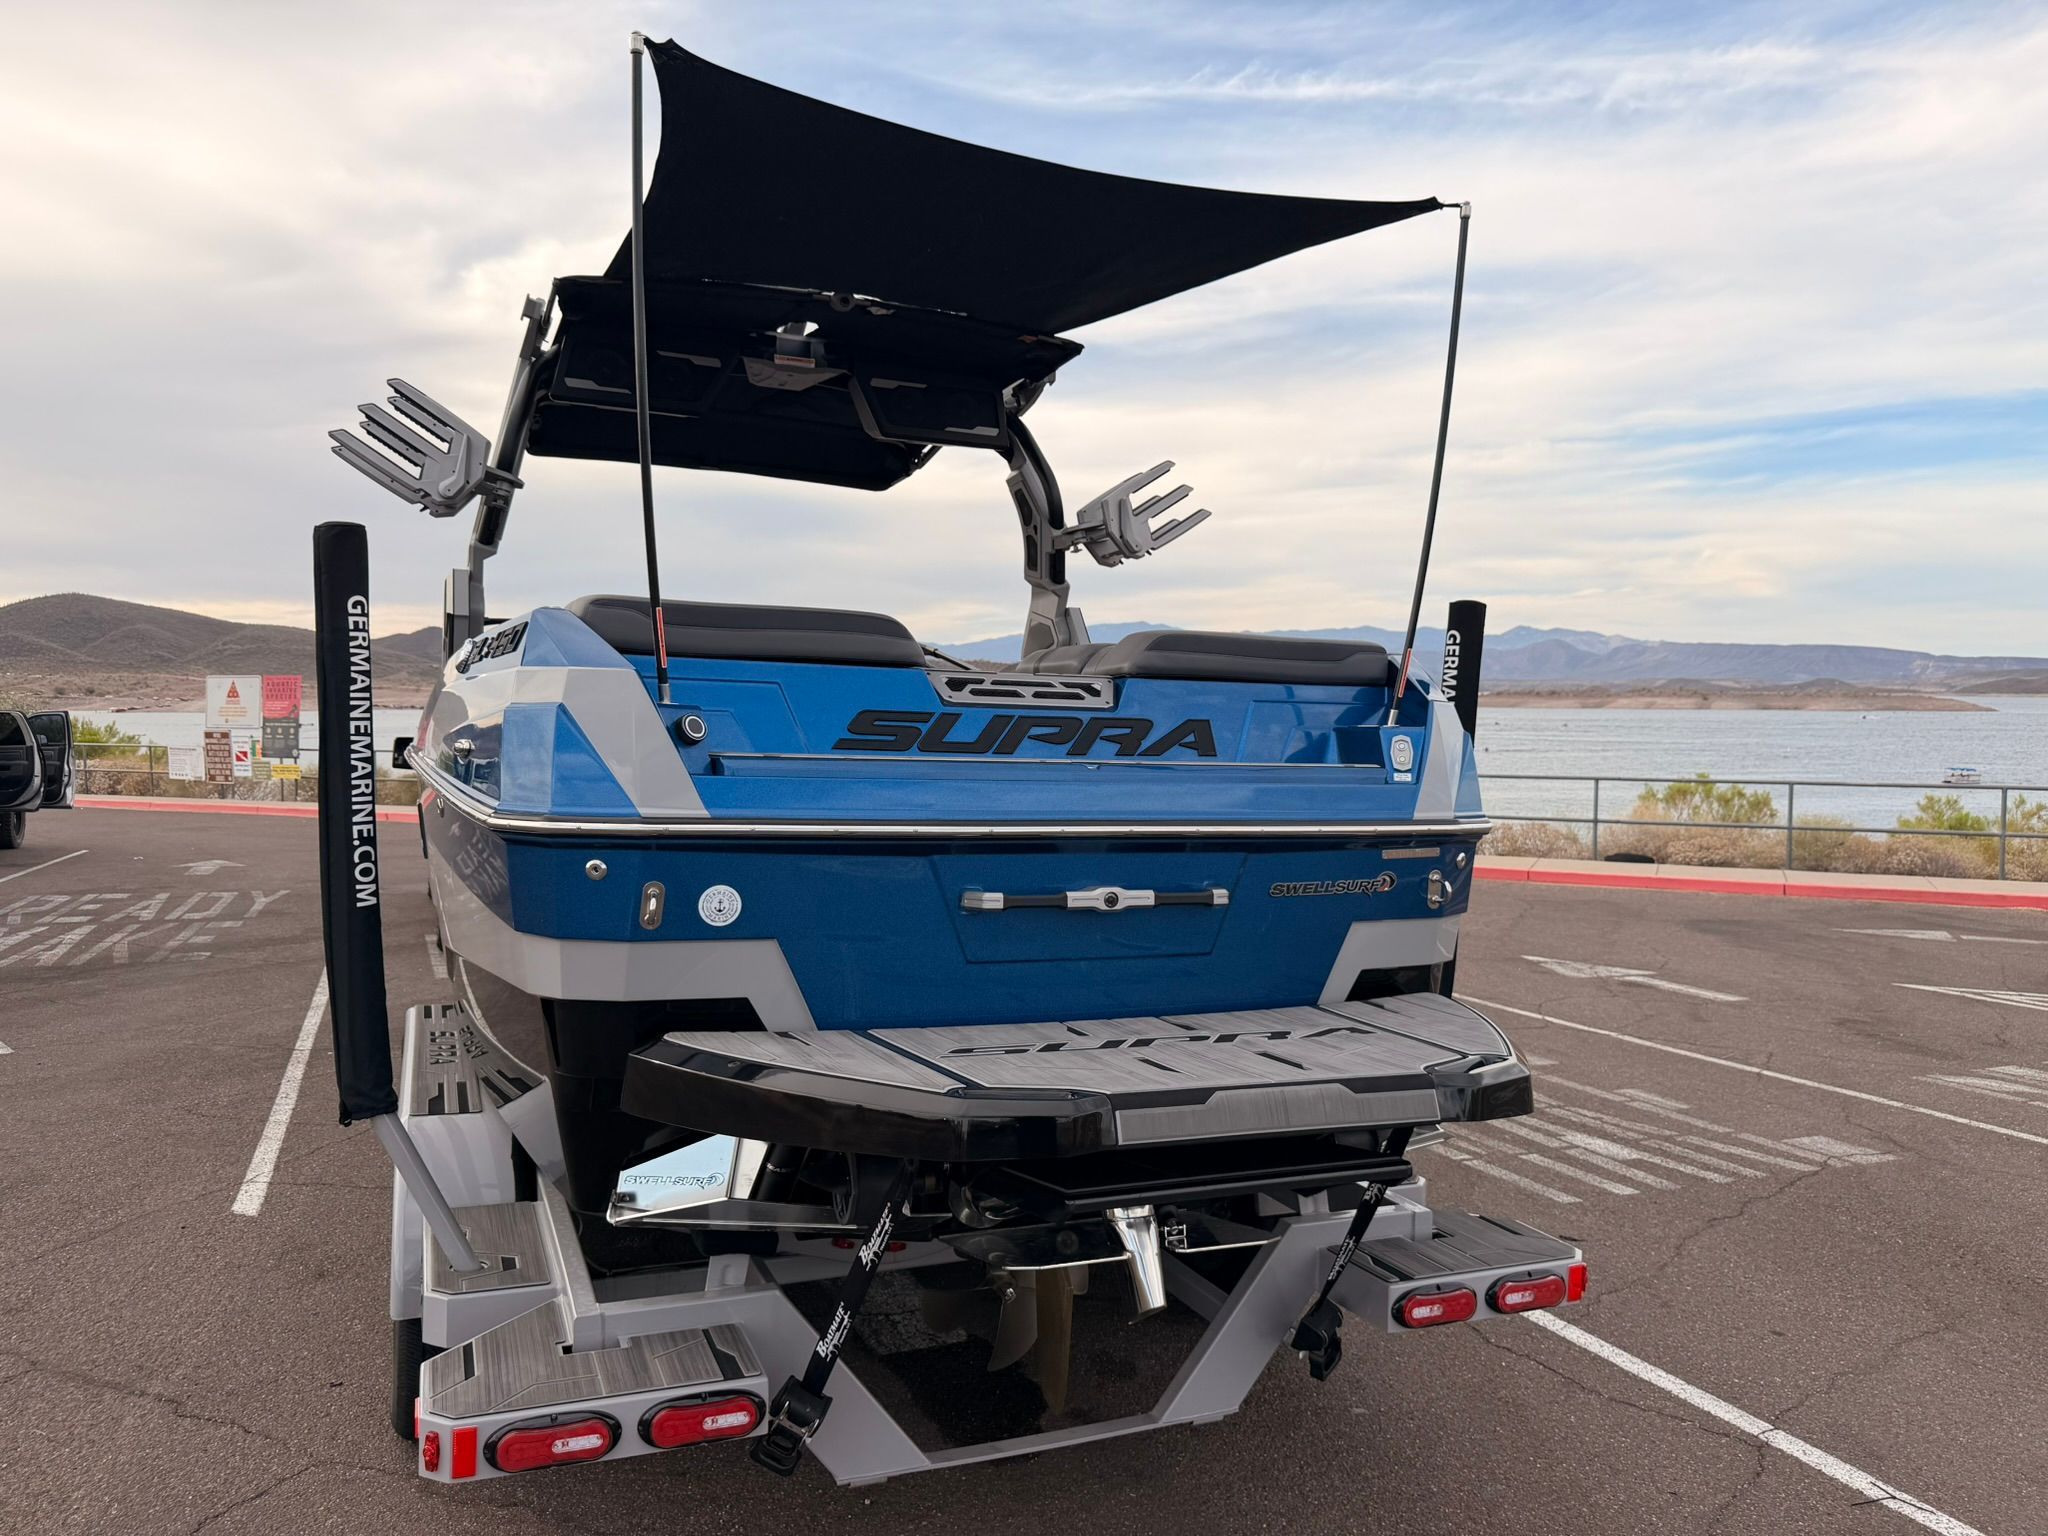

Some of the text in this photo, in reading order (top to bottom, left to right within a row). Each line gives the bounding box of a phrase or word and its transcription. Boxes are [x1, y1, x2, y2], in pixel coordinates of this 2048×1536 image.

[831, 709, 1218, 757] SUPRA
[347, 594, 378, 908] GERMAINEMARINE.COM
[1270, 878, 1384, 898] SWELLSURF
[0, 890, 292, 925] READY
[936, 1026, 1378, 1059] SUPRA
[624, 1174, 714, 1189] SWELLSURF
[816, 1303, 845, 1359] BOATMATE
